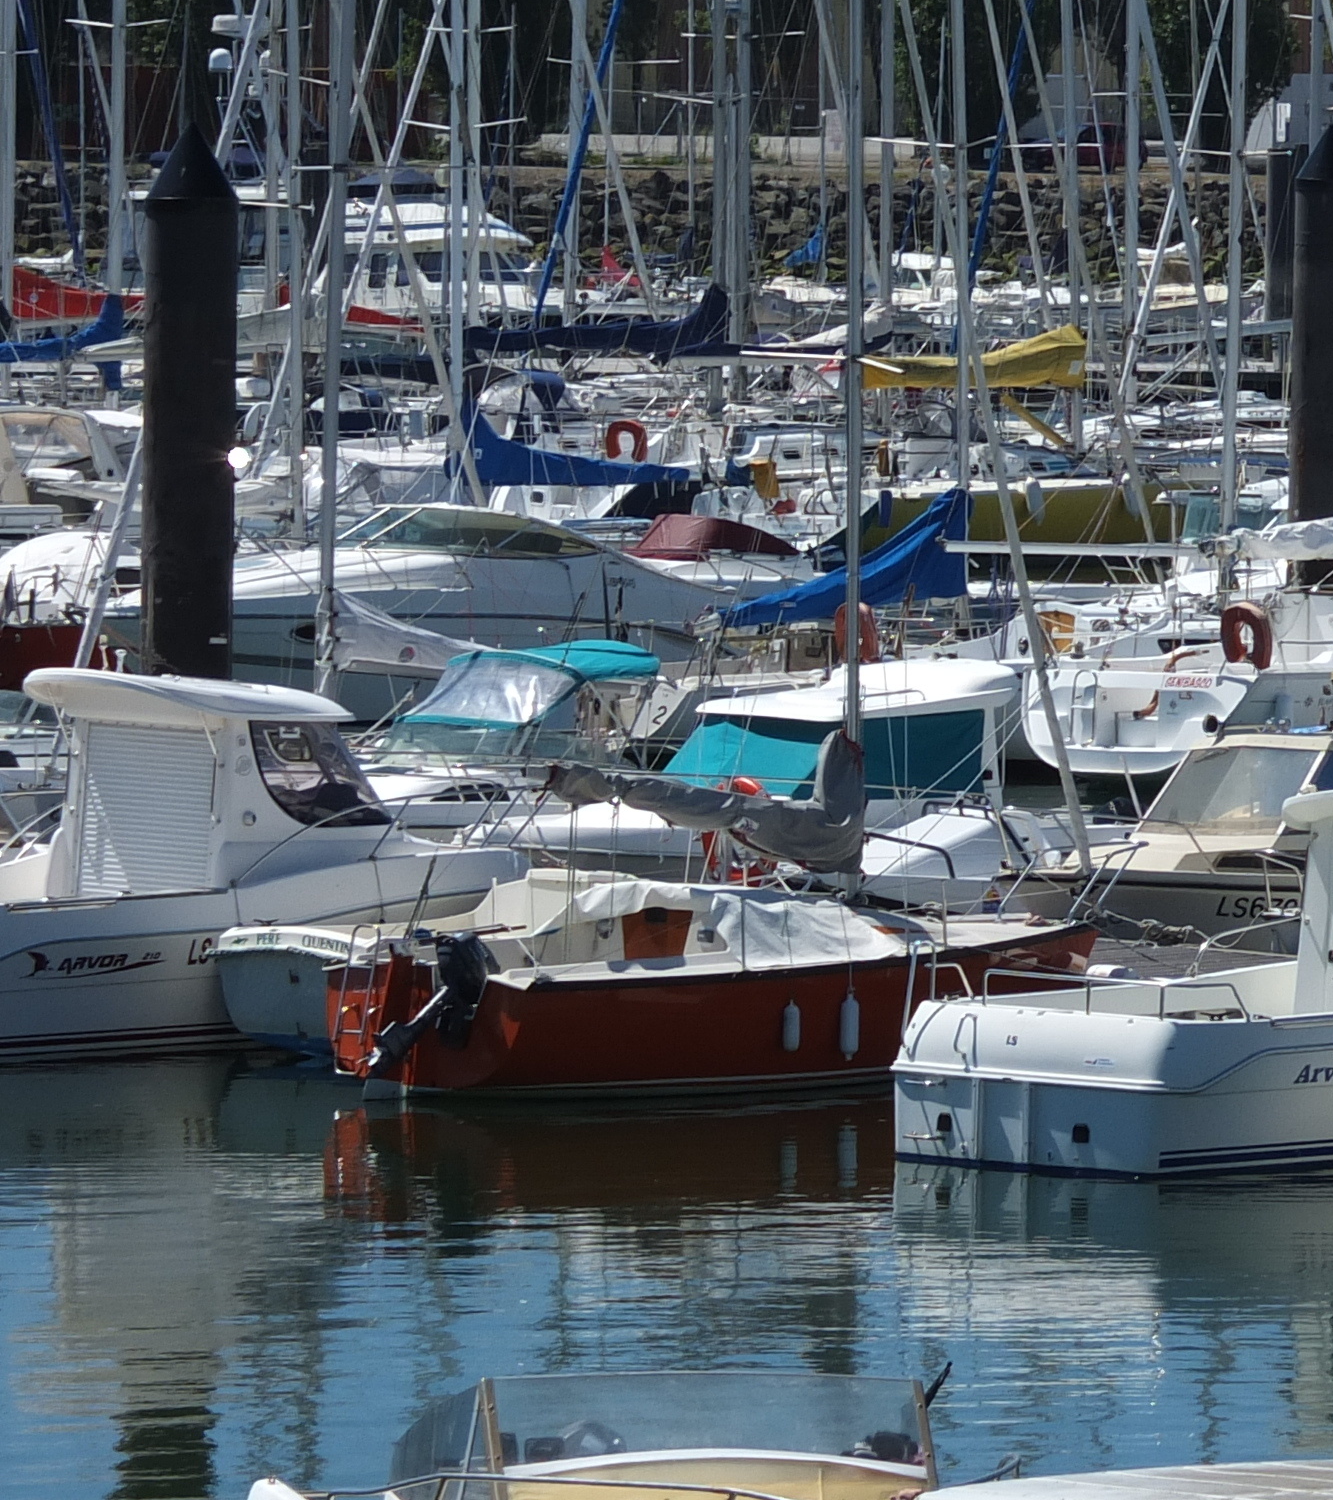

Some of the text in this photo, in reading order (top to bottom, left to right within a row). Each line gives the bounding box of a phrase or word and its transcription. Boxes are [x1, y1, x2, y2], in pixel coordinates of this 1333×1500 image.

[652, 705, 668, 725] 2
[57, 953, 128, 974] ARVOR
[1006, 1034, 1018, 1046] LS
